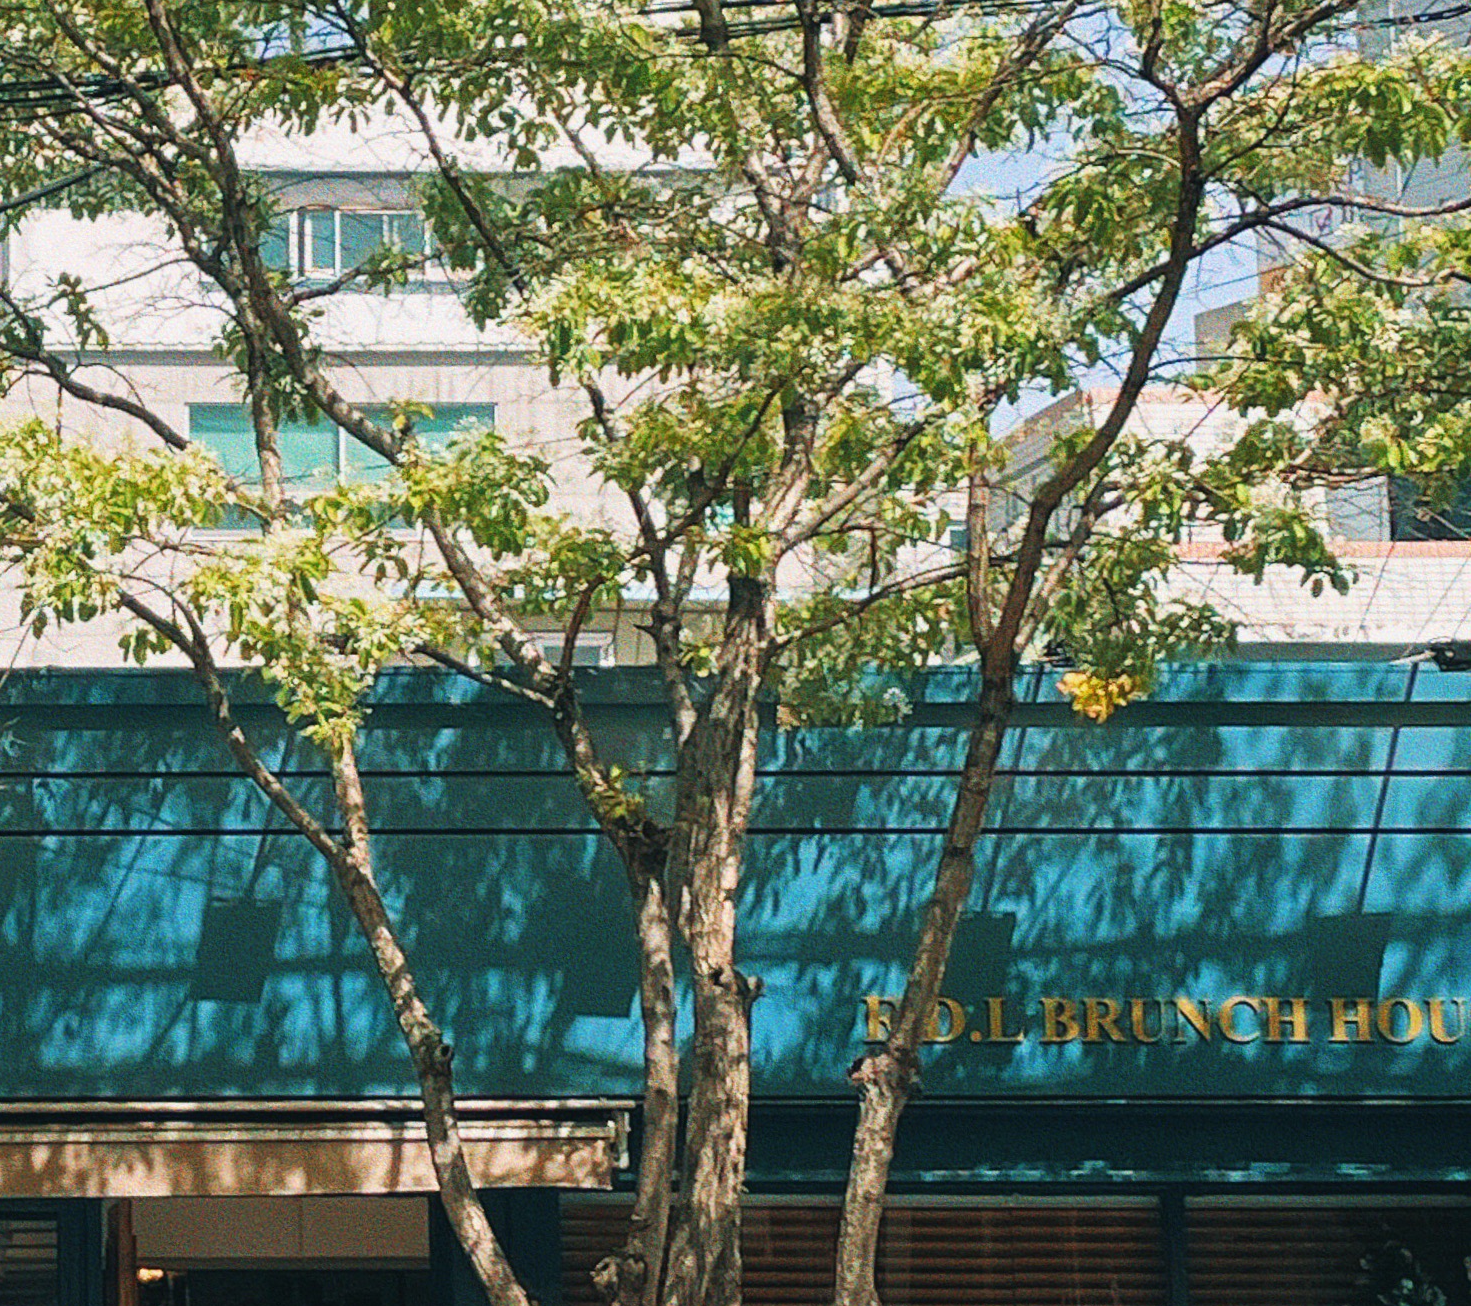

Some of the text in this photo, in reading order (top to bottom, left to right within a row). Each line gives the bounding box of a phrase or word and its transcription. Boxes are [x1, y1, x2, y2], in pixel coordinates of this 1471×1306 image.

[861, 995, 1466, 1043] ED.L BRUNCH HOU
